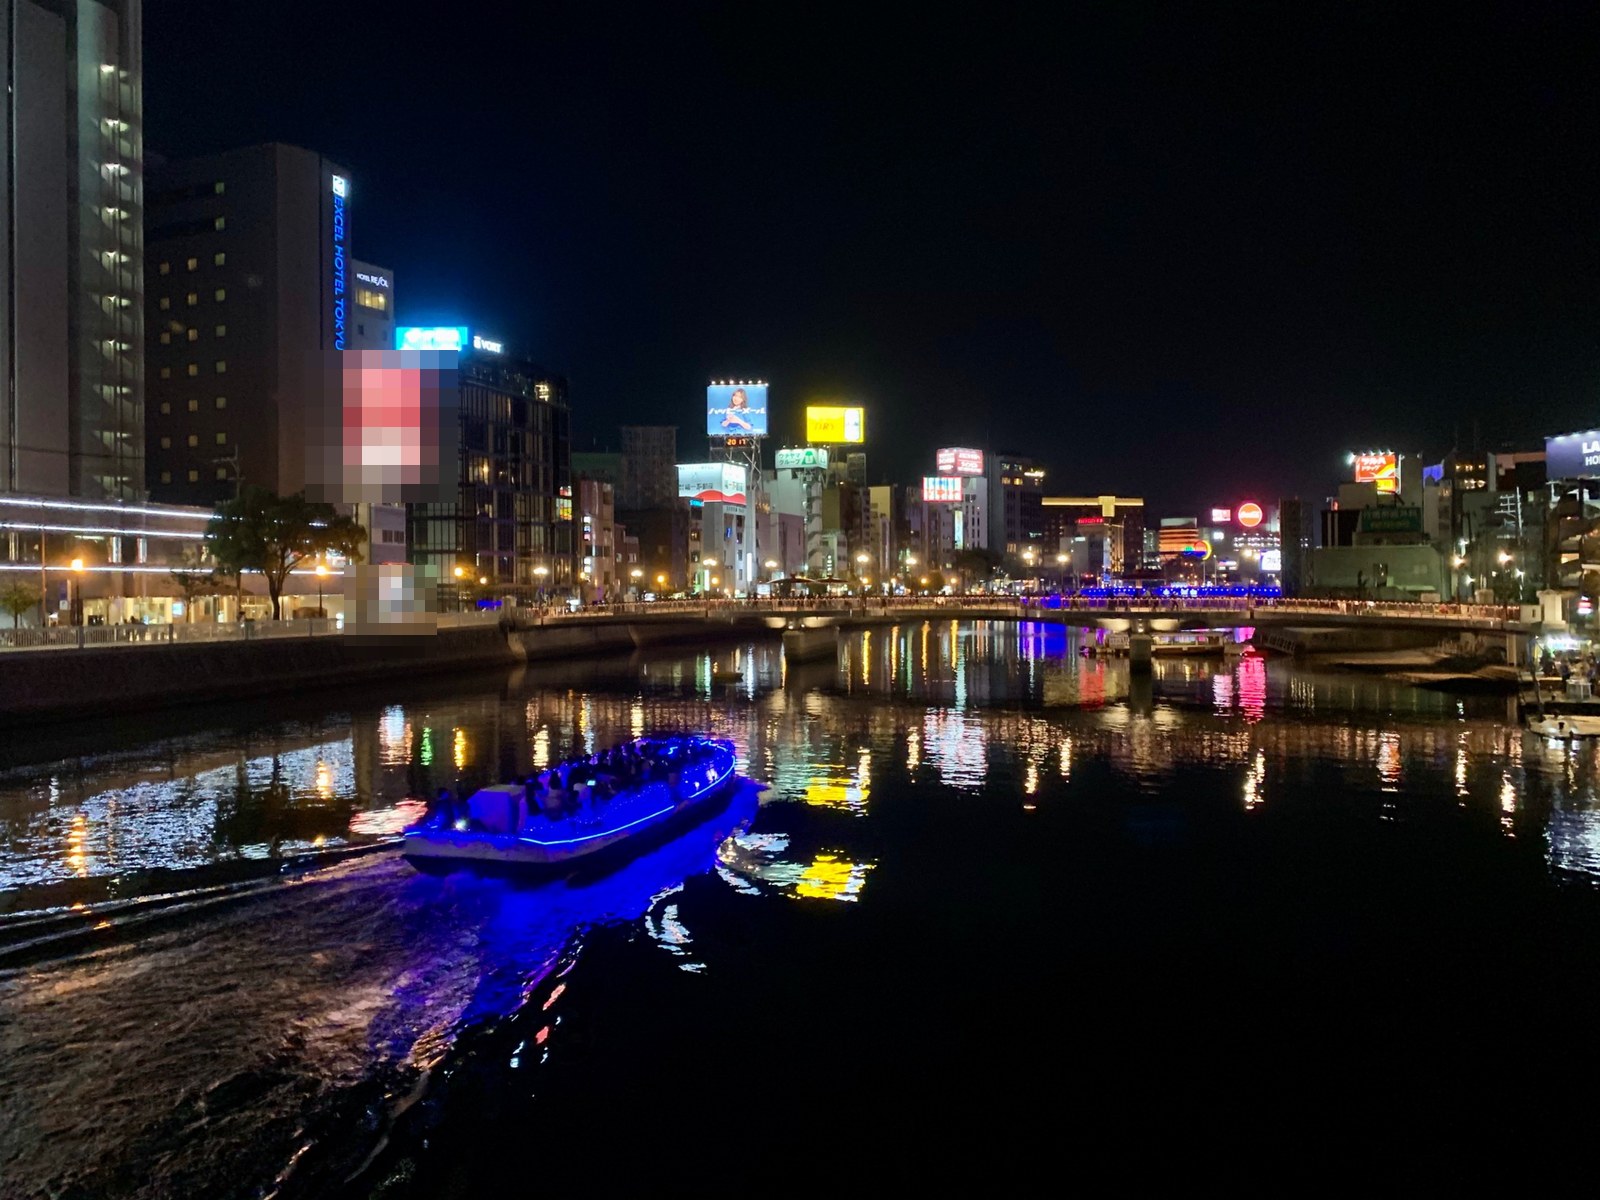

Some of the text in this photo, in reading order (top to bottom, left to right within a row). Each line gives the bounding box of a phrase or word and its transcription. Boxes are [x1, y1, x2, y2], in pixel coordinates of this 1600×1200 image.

[334, 195, 344, 350] EXCEL HOTEL TOKYU
[356, 273, 371, 282] HOTEL
[1361, 457, 1387, 465] ツルハ
[1585, 455, 1600, 466] HO
